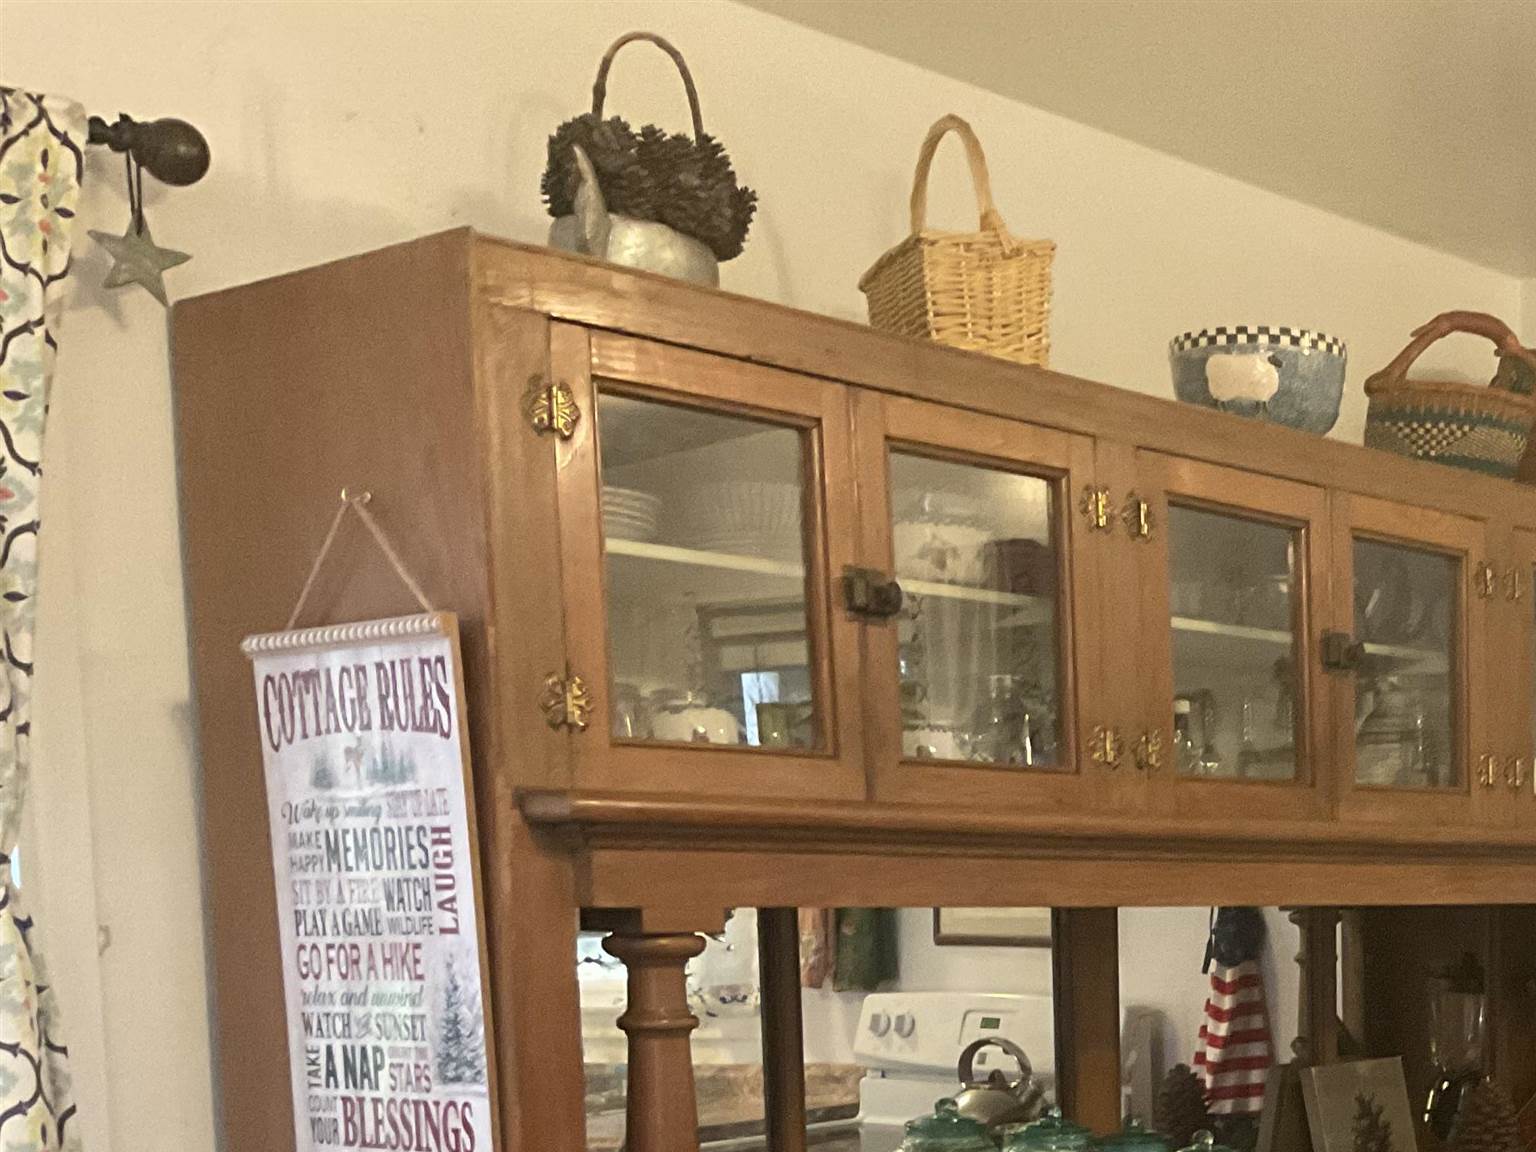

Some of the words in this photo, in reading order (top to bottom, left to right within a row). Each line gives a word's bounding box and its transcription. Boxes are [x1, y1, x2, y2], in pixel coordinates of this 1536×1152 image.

[263, 664, 372, 752] COTTAGE
[375, 655, 451, 739] RULES
[288, 830, 322, 849] MAKE
[325, 825, 430, 872] MEMORIES
[289, 854, 324, 873] HAPPY
[383, 877, 432, 912] WATCH
[431, 826, 460, 935] LAUGH
[294, 909, 326, 936] PLAY
[331, 909, 340, 936] A
[342, 908, 382, 936] GAME
[386, 916, 434, 935] WILDLIFE
[297, 944, 322, 980] GO
[326, 943, 362, 981] FOR
[366, 943, 376, 981] A
[382, 943, 425, 981] HIKE
[301, 1012, 352, 1039] WATCH
[375, 1012, 427, 1041] SUNSET
[306, 1044, 322, 1089] TAKE
[325, 1044, 339, 1089] A
[342, 1044, 385, 1090] NAP
[389, 1062, 432, 1093] STARS
[310, 1117, 340, 1145] YOUR
